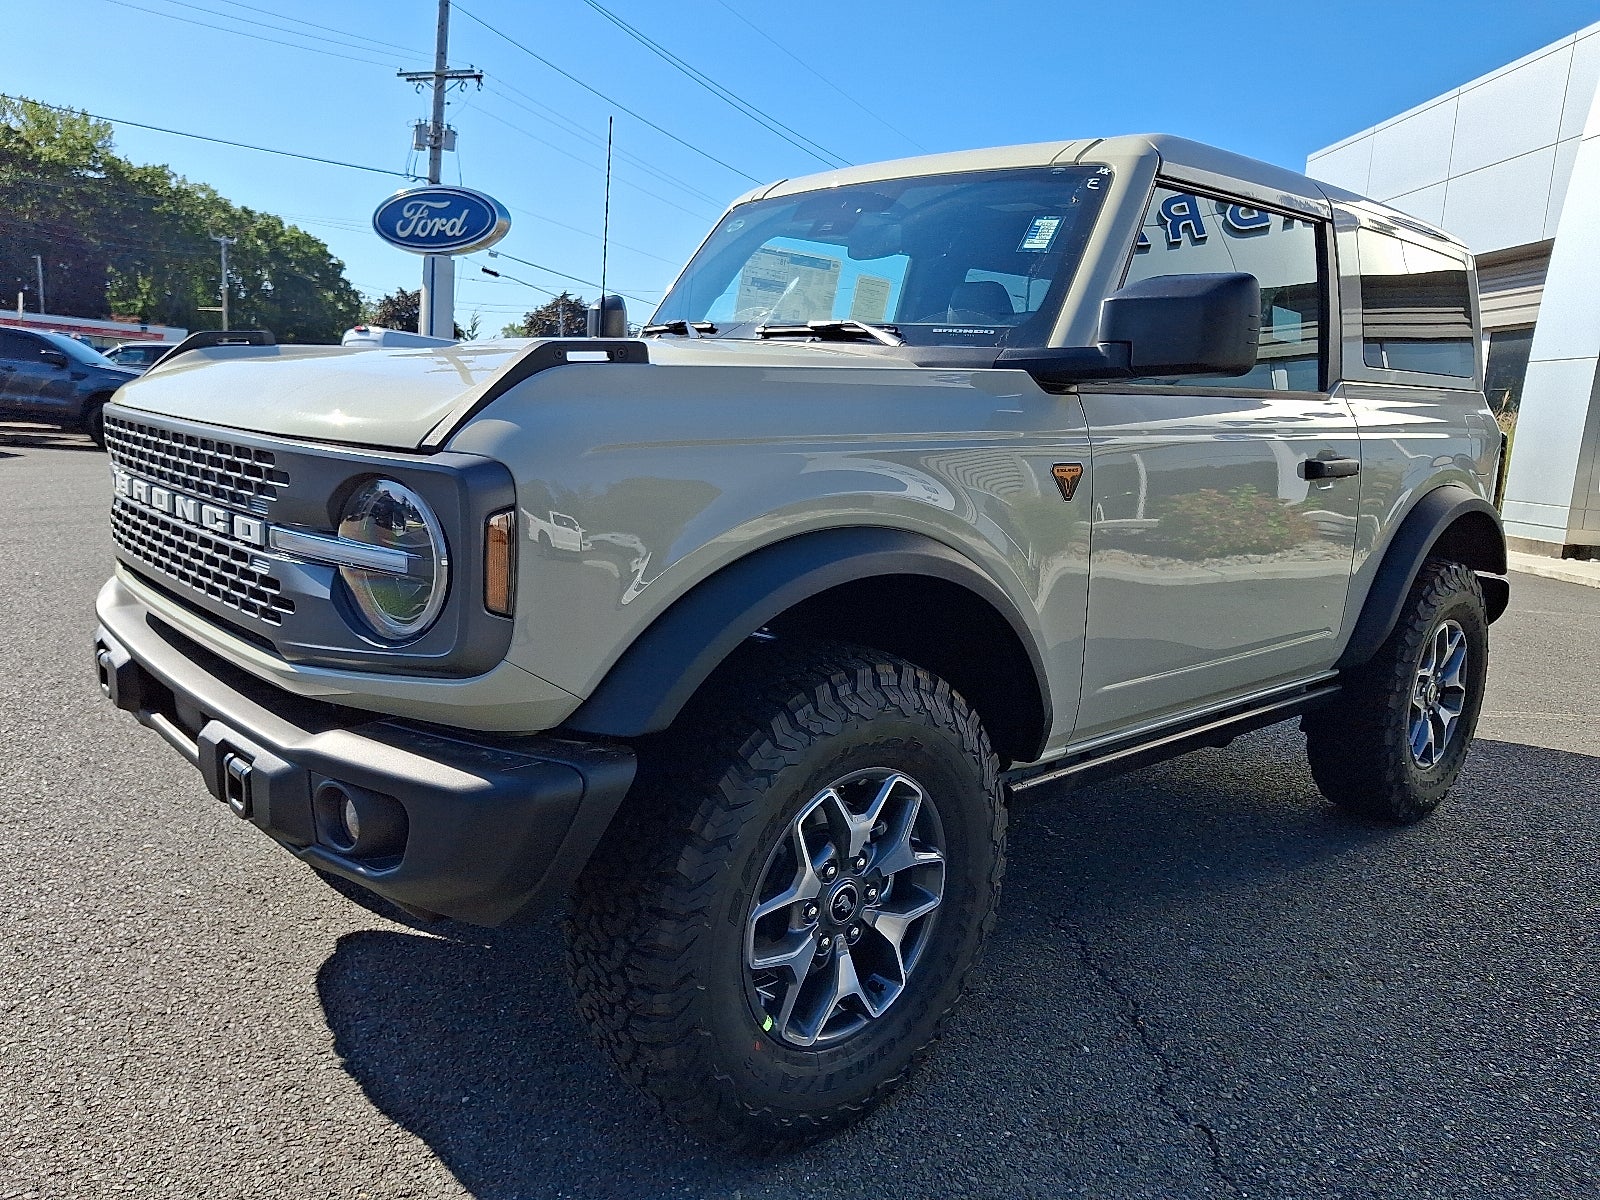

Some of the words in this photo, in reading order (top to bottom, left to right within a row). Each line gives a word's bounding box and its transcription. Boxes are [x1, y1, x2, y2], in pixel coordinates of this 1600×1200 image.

[396, 199, 470, 238] Ford
[932, 327, 996, 335] BRONCO
[114, 469, 266, 546] BRONCO
